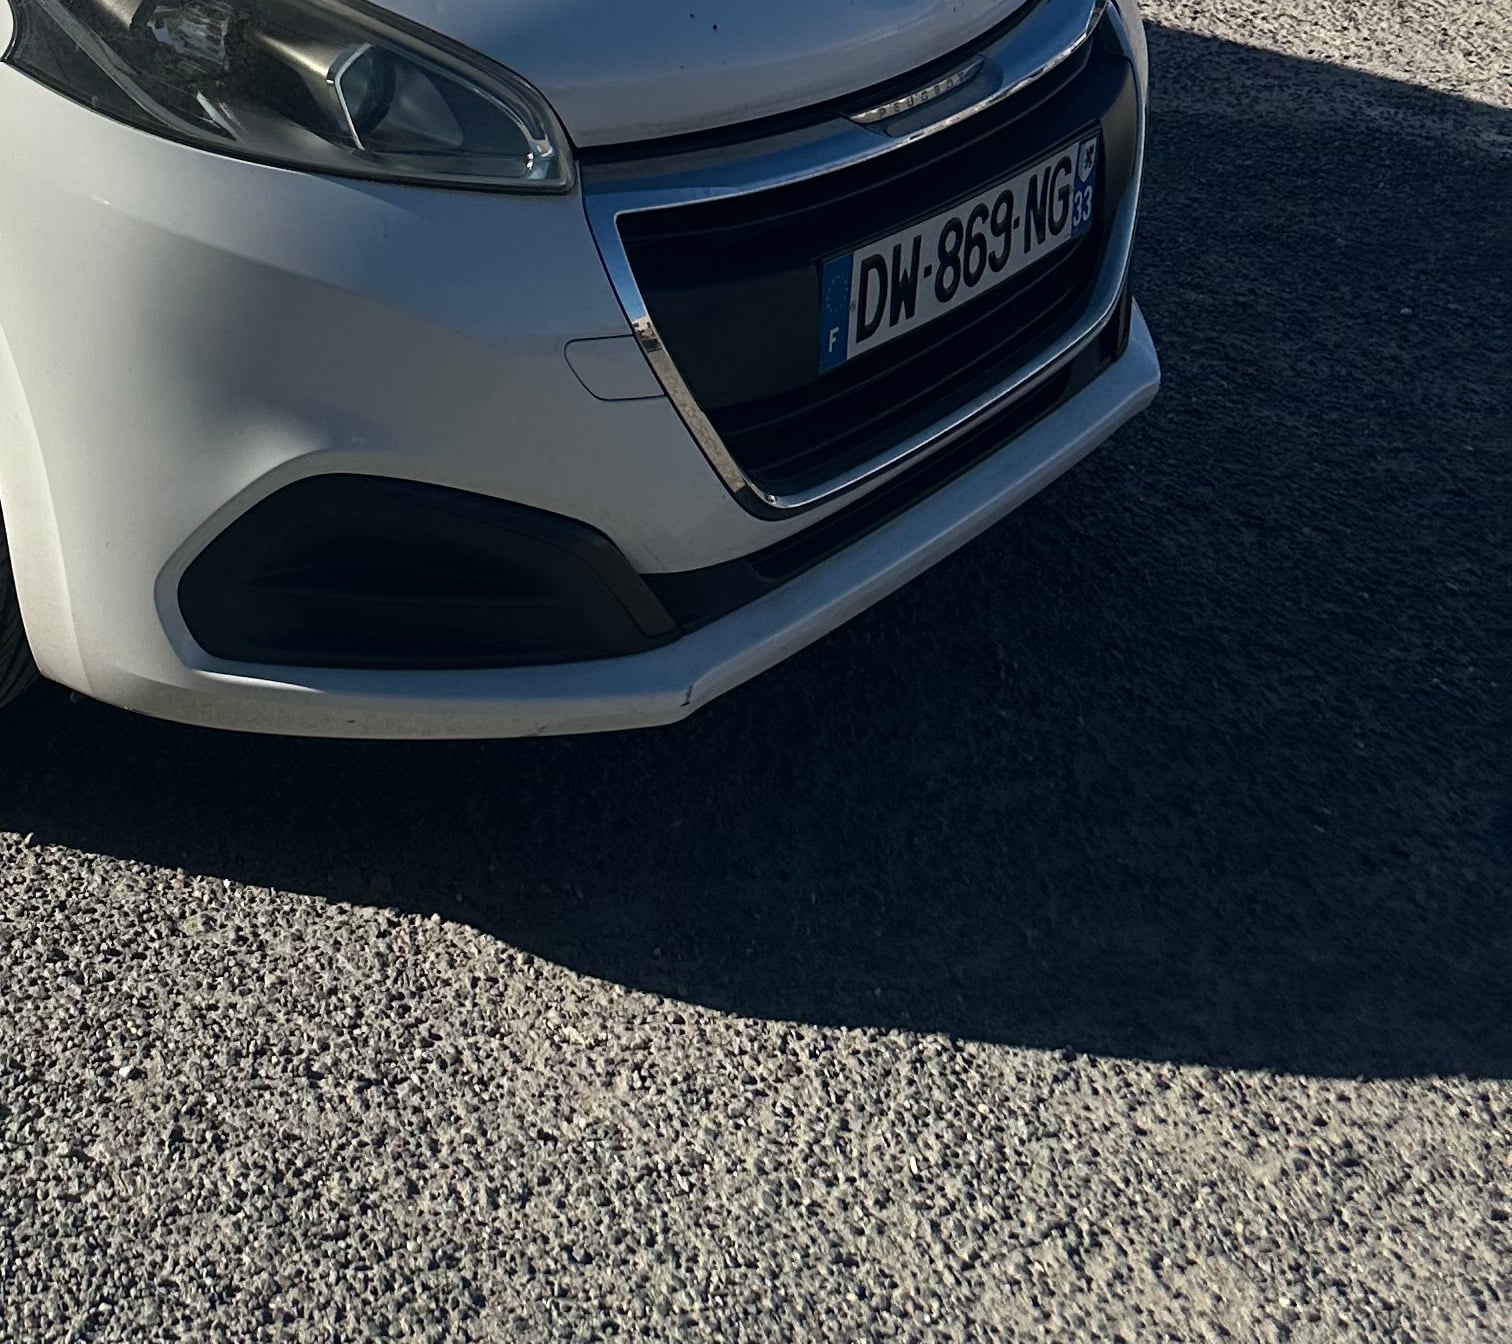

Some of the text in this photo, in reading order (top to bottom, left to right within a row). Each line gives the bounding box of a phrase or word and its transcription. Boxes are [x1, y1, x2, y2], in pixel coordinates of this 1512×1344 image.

[878, 71, 967, 118] PEUGEOT
[1072, 185, 1093, 228] 33
[856, 156, 1072, 344] DW-869-NG
[828, 326, 839, 353] F
